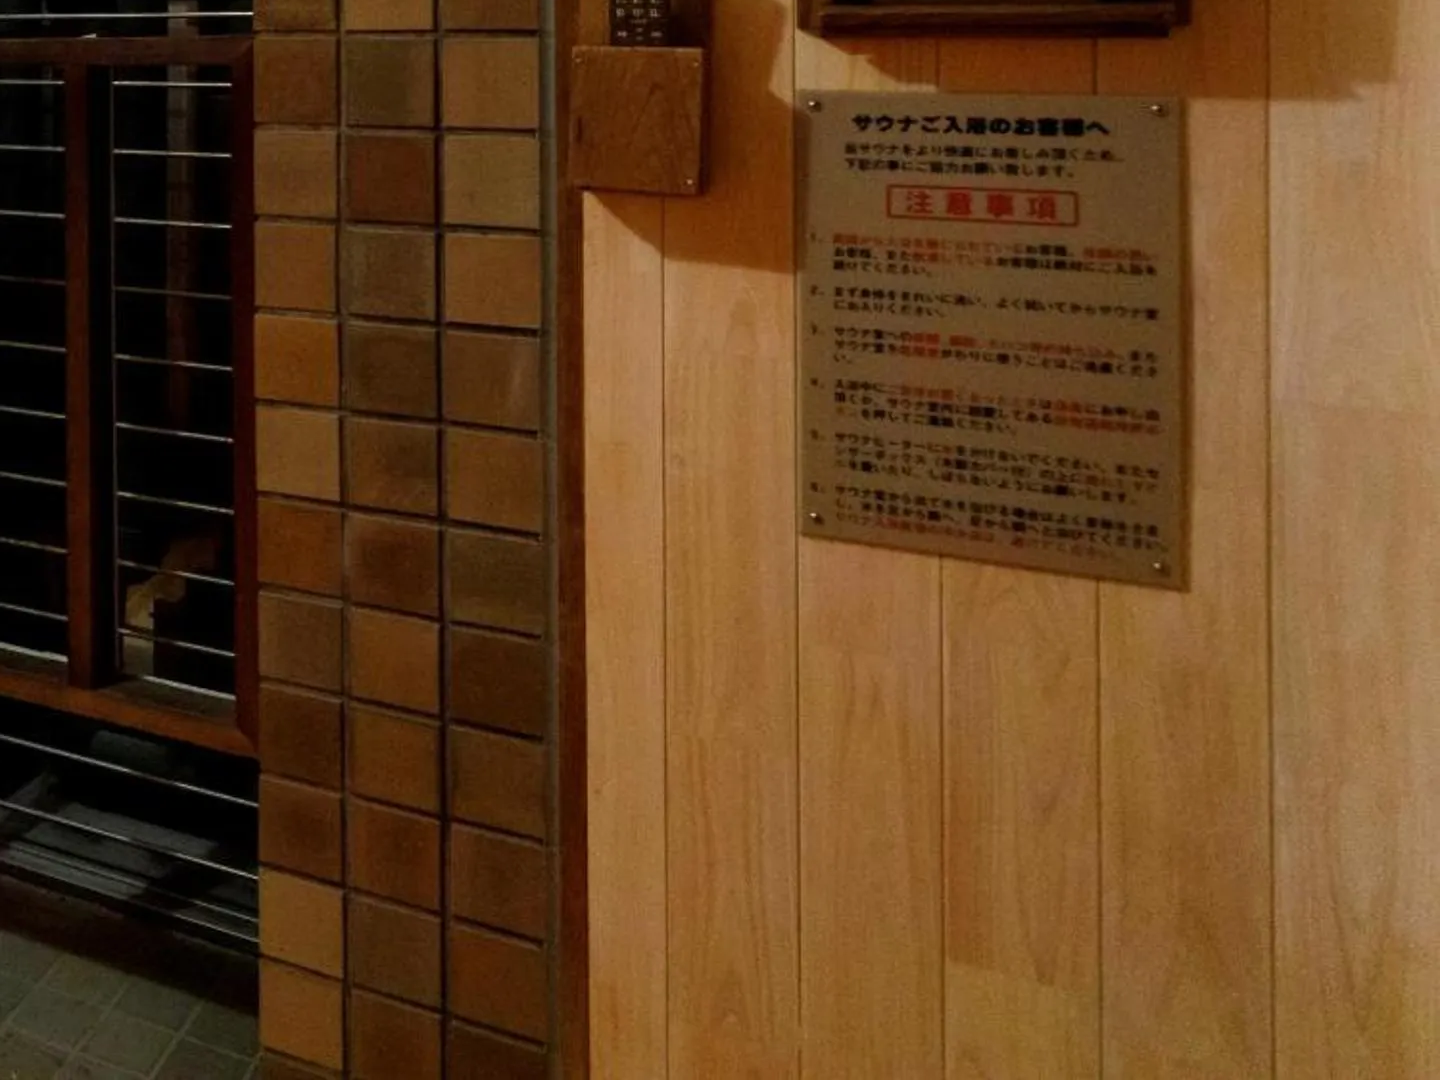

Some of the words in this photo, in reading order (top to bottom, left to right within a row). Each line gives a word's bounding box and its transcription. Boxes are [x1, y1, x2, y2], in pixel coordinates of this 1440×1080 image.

[851, 114, 1111, 137] サウナご入浴のお客様へ
